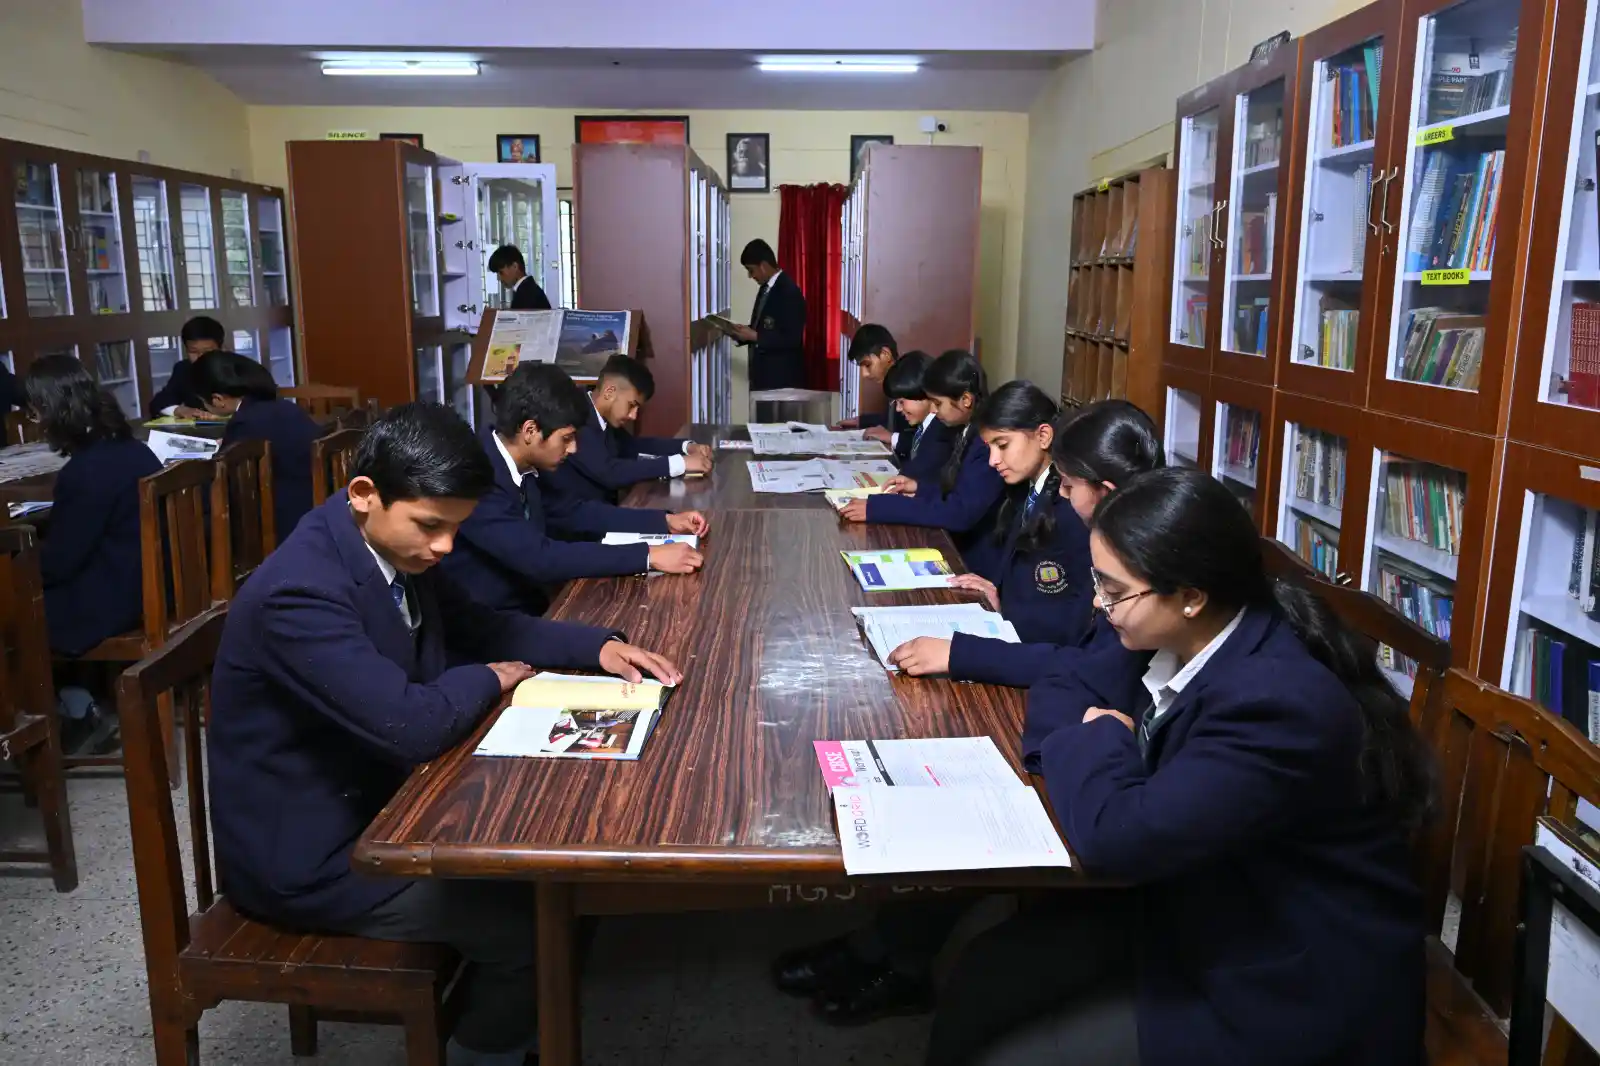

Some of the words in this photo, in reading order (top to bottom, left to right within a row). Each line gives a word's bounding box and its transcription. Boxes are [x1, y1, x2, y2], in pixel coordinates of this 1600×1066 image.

[327, 131, 367, 139] SILENCE
[1442, 272, 1464, 280] BOOKS
[825, 751, 848, 773] CBSE
[849, 794, 865, 818] GRID
[853, 818, 871, 849] WORD
